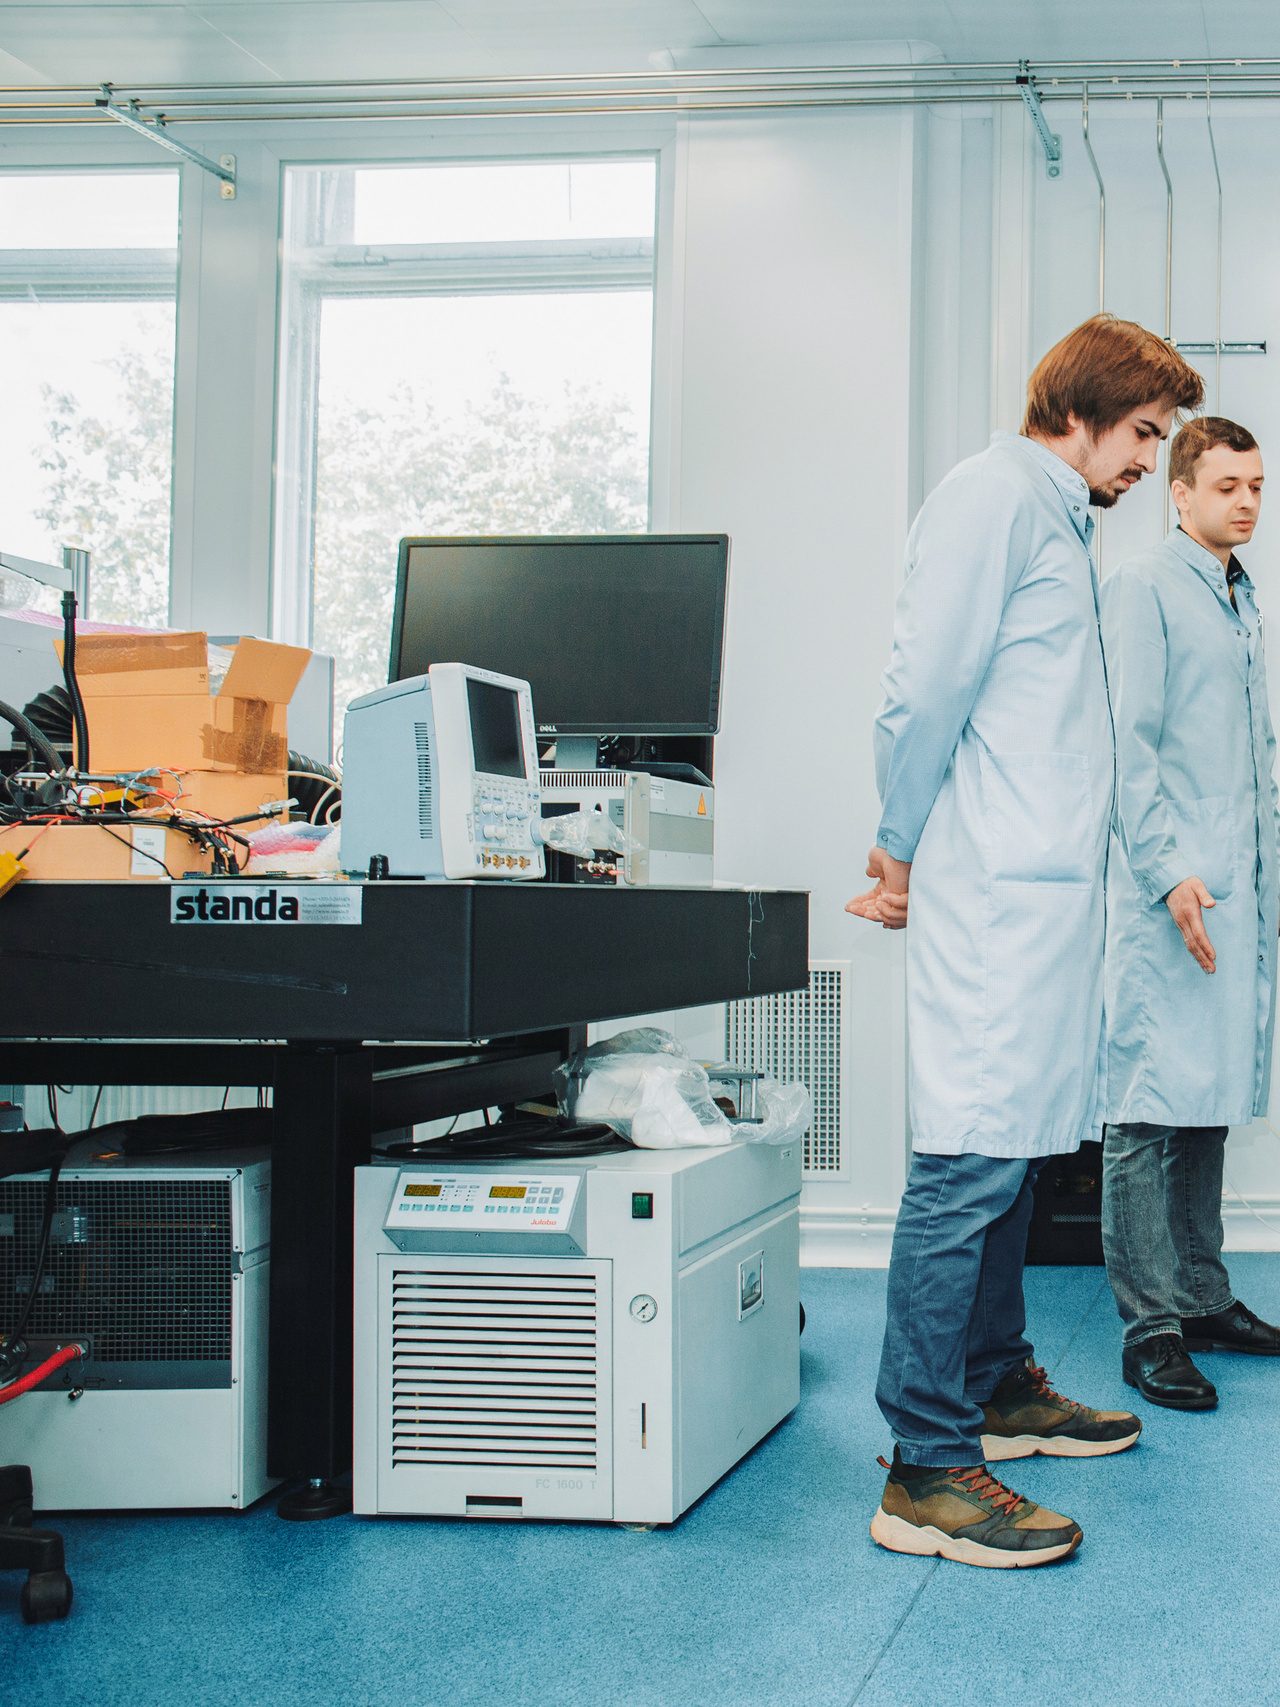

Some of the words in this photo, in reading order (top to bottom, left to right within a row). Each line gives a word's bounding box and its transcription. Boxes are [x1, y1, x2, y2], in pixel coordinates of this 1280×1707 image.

[176, 889, 299, 920] standa
[535, 1478, 550, 1489] FC
[556, 1479, 583, 1490] 1600
